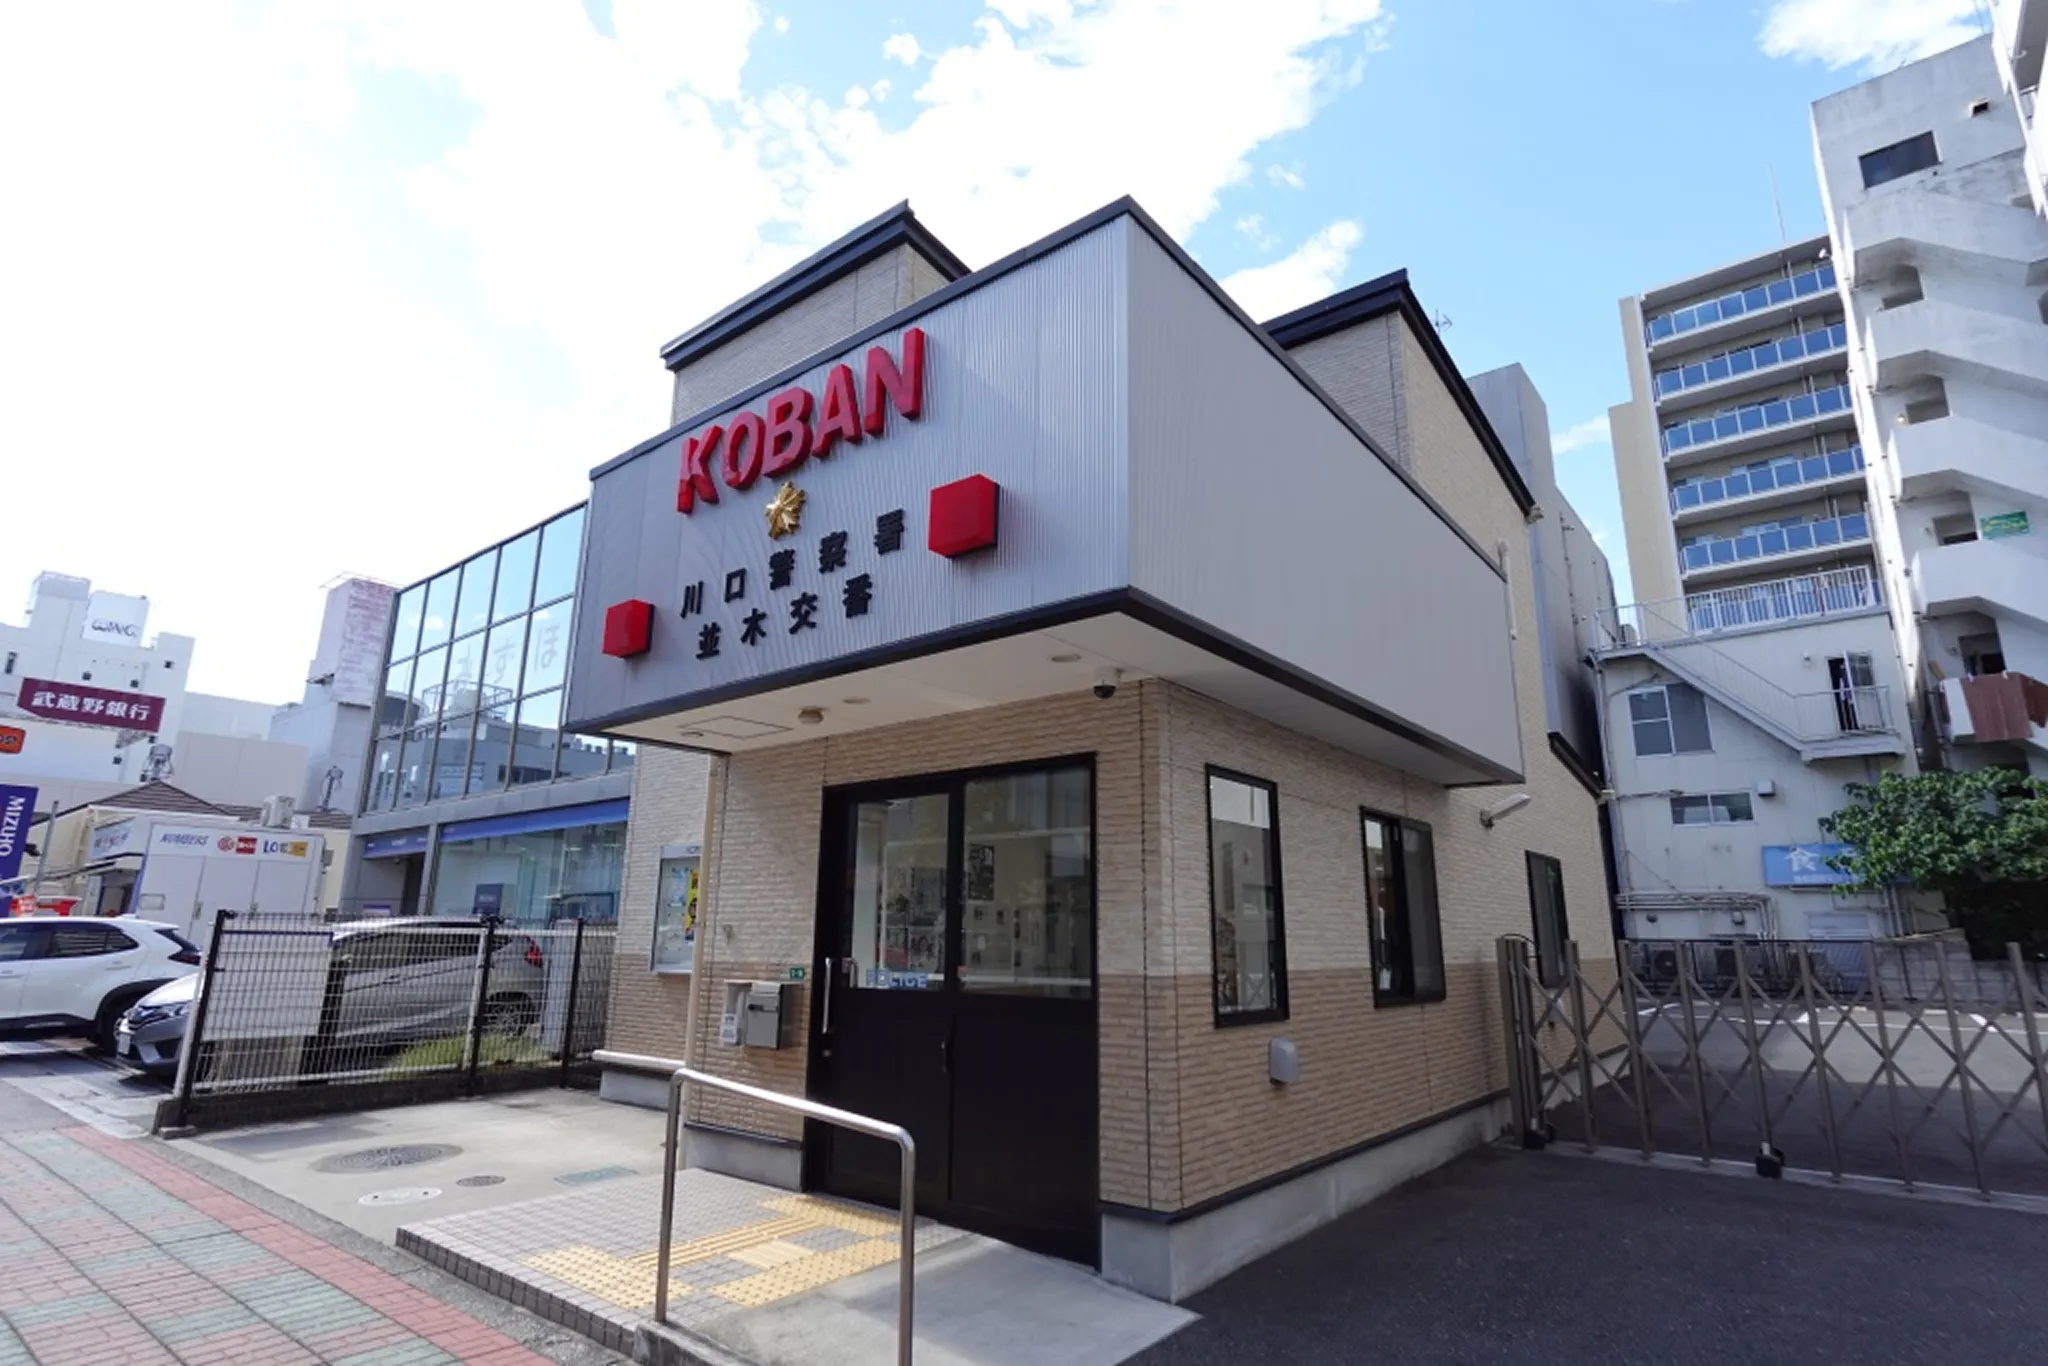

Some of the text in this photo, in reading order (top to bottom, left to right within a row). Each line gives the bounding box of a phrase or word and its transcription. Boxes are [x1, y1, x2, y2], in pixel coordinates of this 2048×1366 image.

[676, 327, 925, 513] KOBAN
[681, 508, 904, 618] 川口警察署
[696, 573, 873, 659] 並木交番
[31, 691, 151, 721] 武蔵野銀行
[0, 796, 26, 857] MIZUHO
